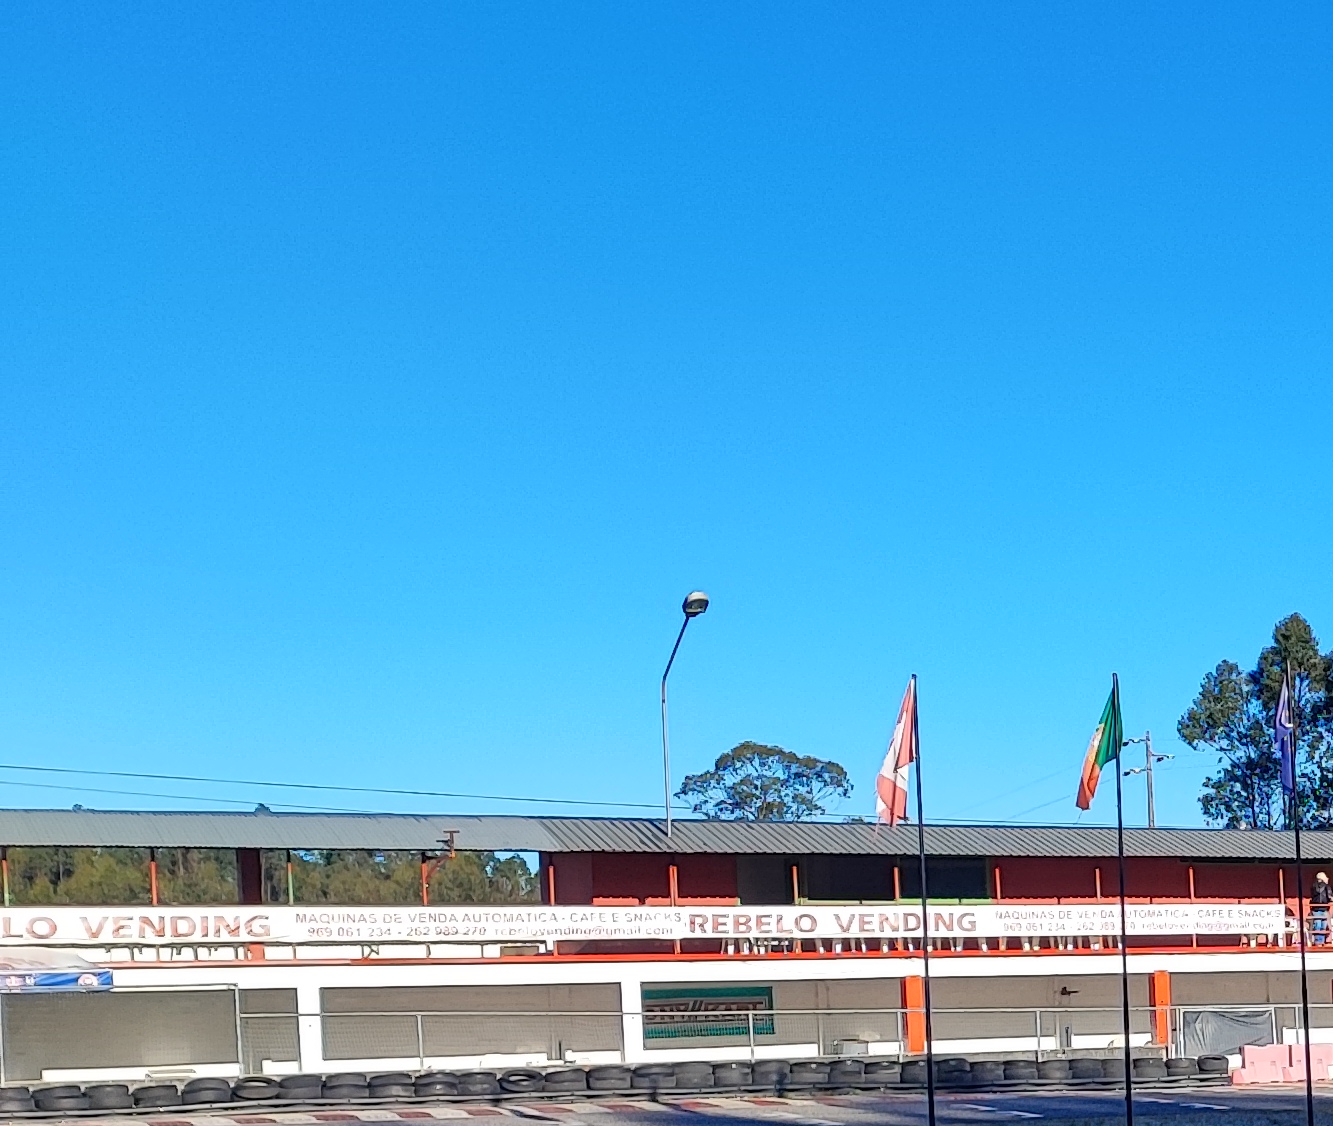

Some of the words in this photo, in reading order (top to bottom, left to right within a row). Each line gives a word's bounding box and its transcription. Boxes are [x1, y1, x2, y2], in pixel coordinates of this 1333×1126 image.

[295, 912, 378, 925] MAQUINAS
[382, 912, 403, 924] DE
[407, 912, 459, 924] VENDA
[461, 911, 558, 924] AUTOMATICA
[611, 911, 620, 923] E
[624, 911, 682, 923] SNACKS
[688, 913, 819, 934] REBELO
[833, 912, 978, 934] VENDING
[1058, 910, 1073, 920] DE
[1, 916, 58, 940] LO
[79, 914, 272, 939] VENDING
